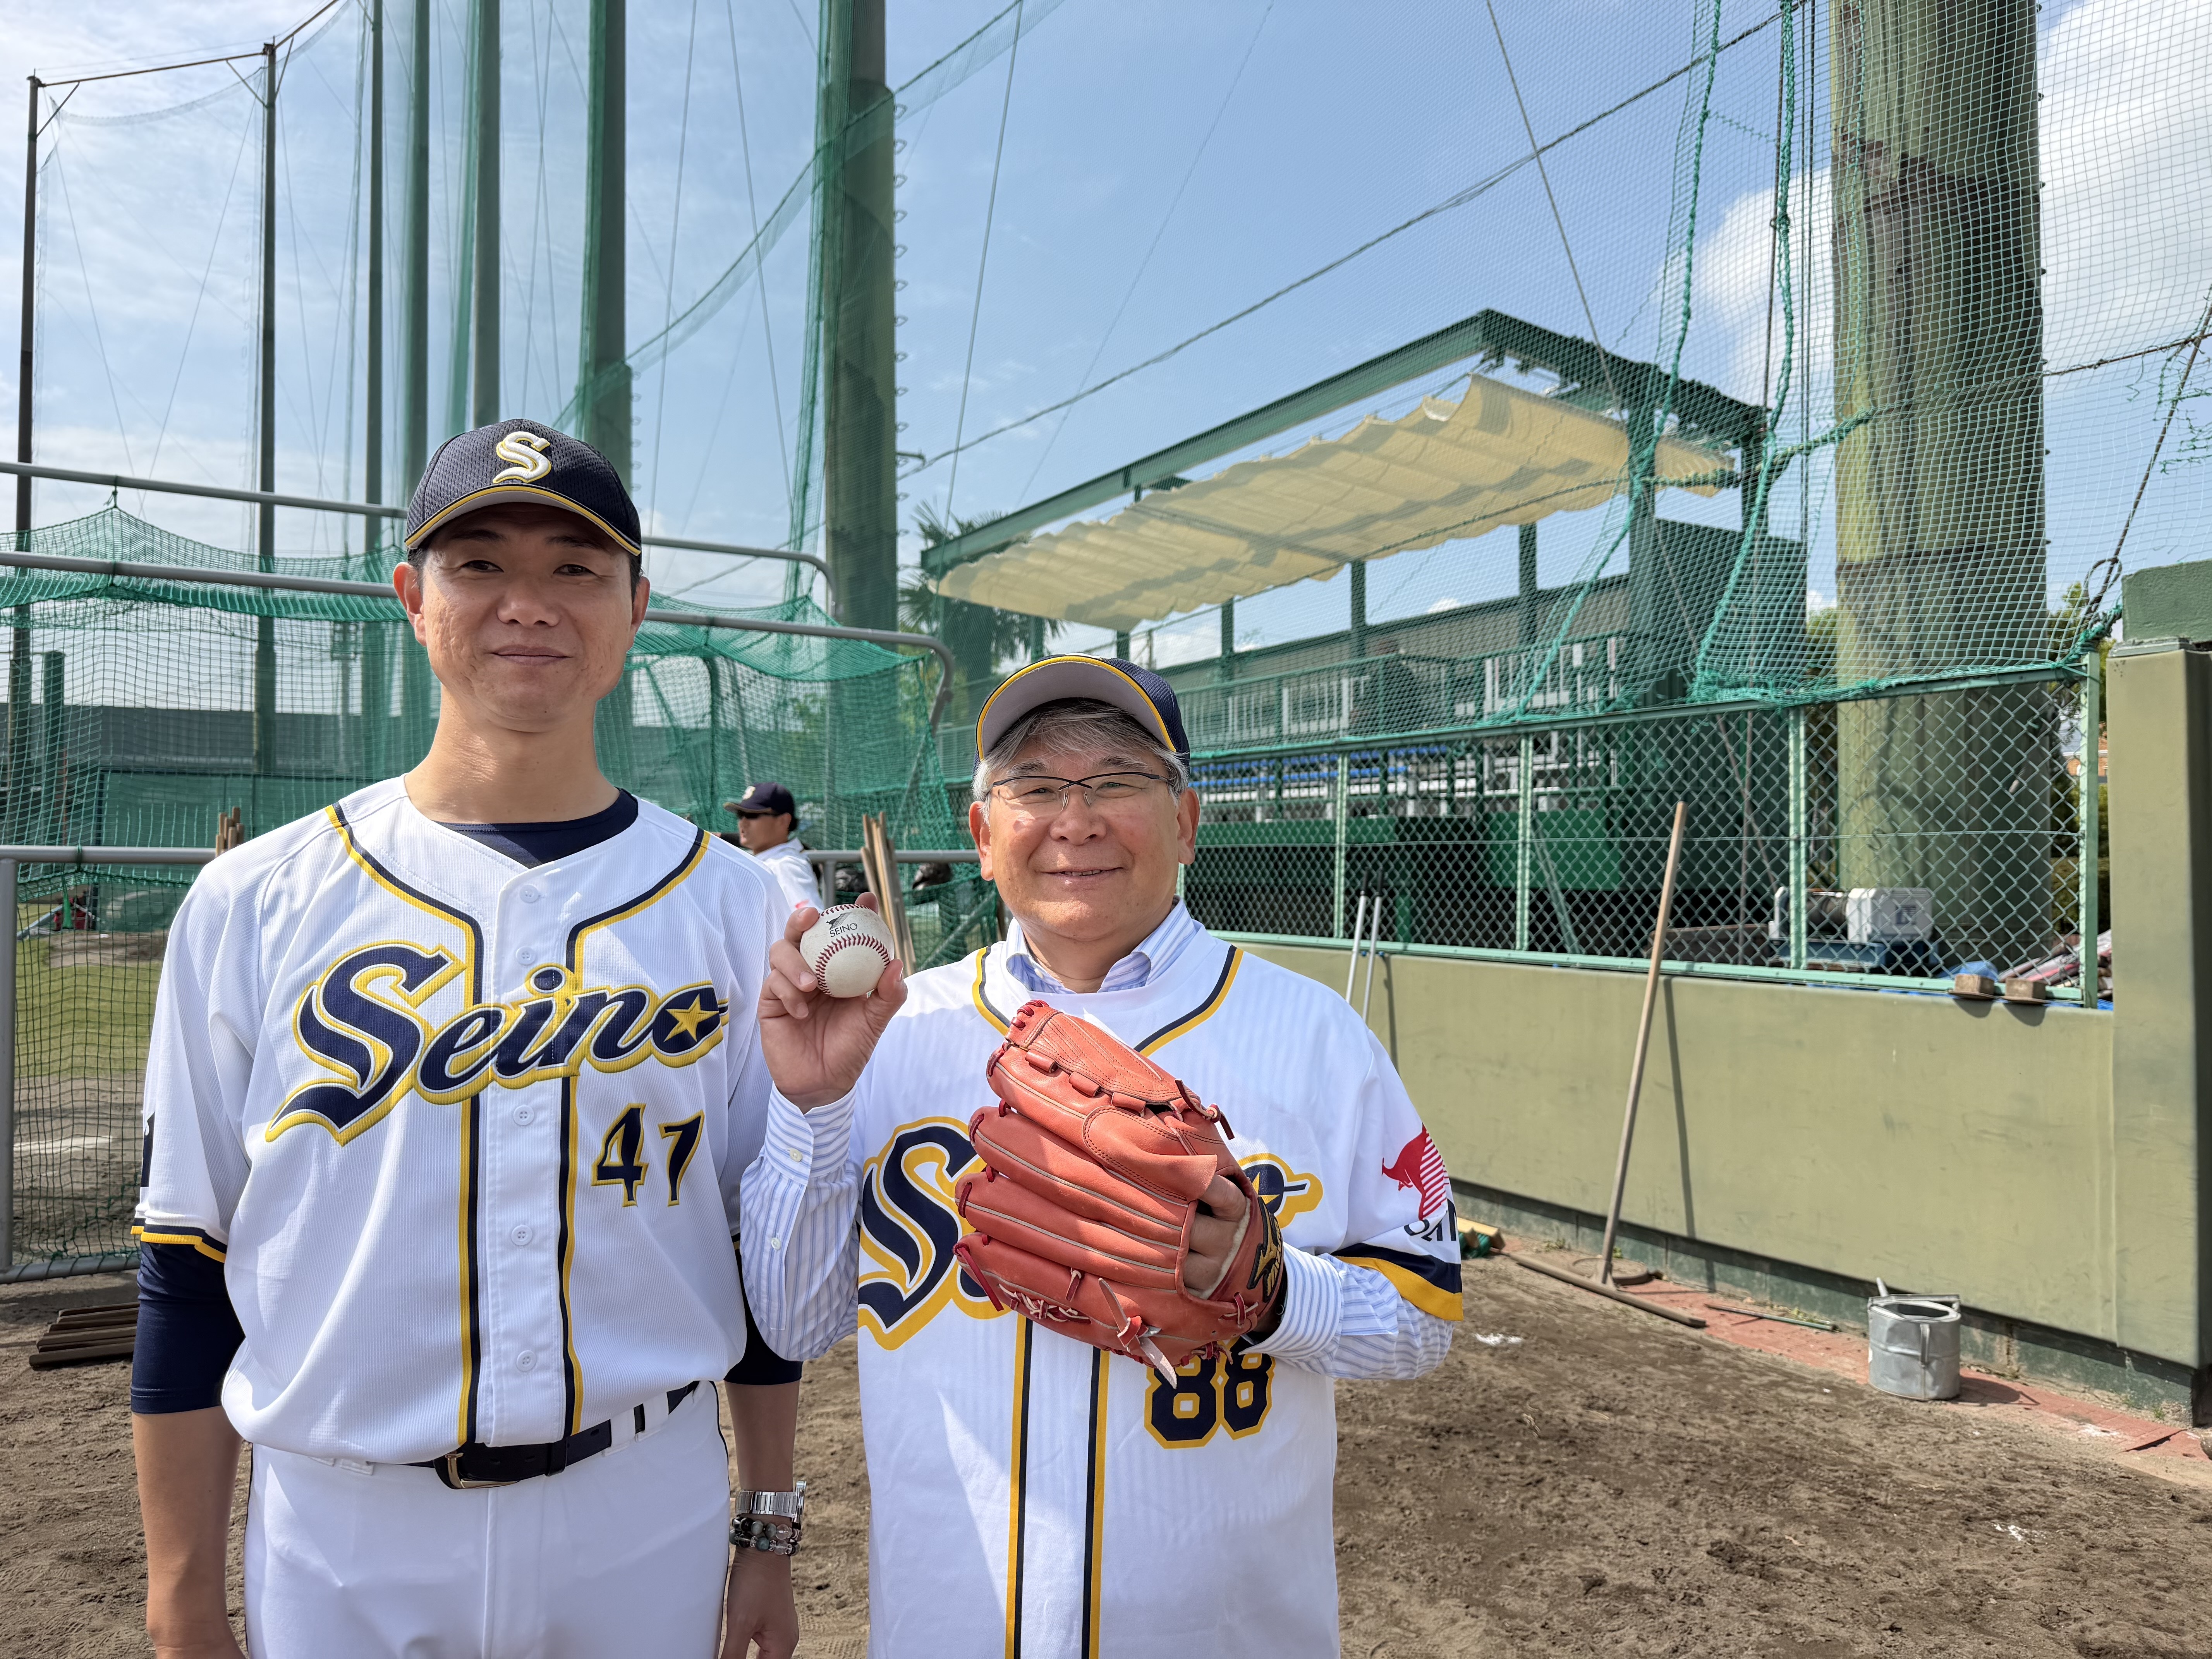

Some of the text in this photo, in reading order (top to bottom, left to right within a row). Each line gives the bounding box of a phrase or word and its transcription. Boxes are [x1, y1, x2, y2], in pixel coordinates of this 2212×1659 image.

[493, 431, 551, 484] S
[830, 923, 858, 938] SEINO
[265, 939, 730, 1146] Seino
[591, 1103, 704, 1206] 47
[1144, 1339, 1276, 1449] 88
